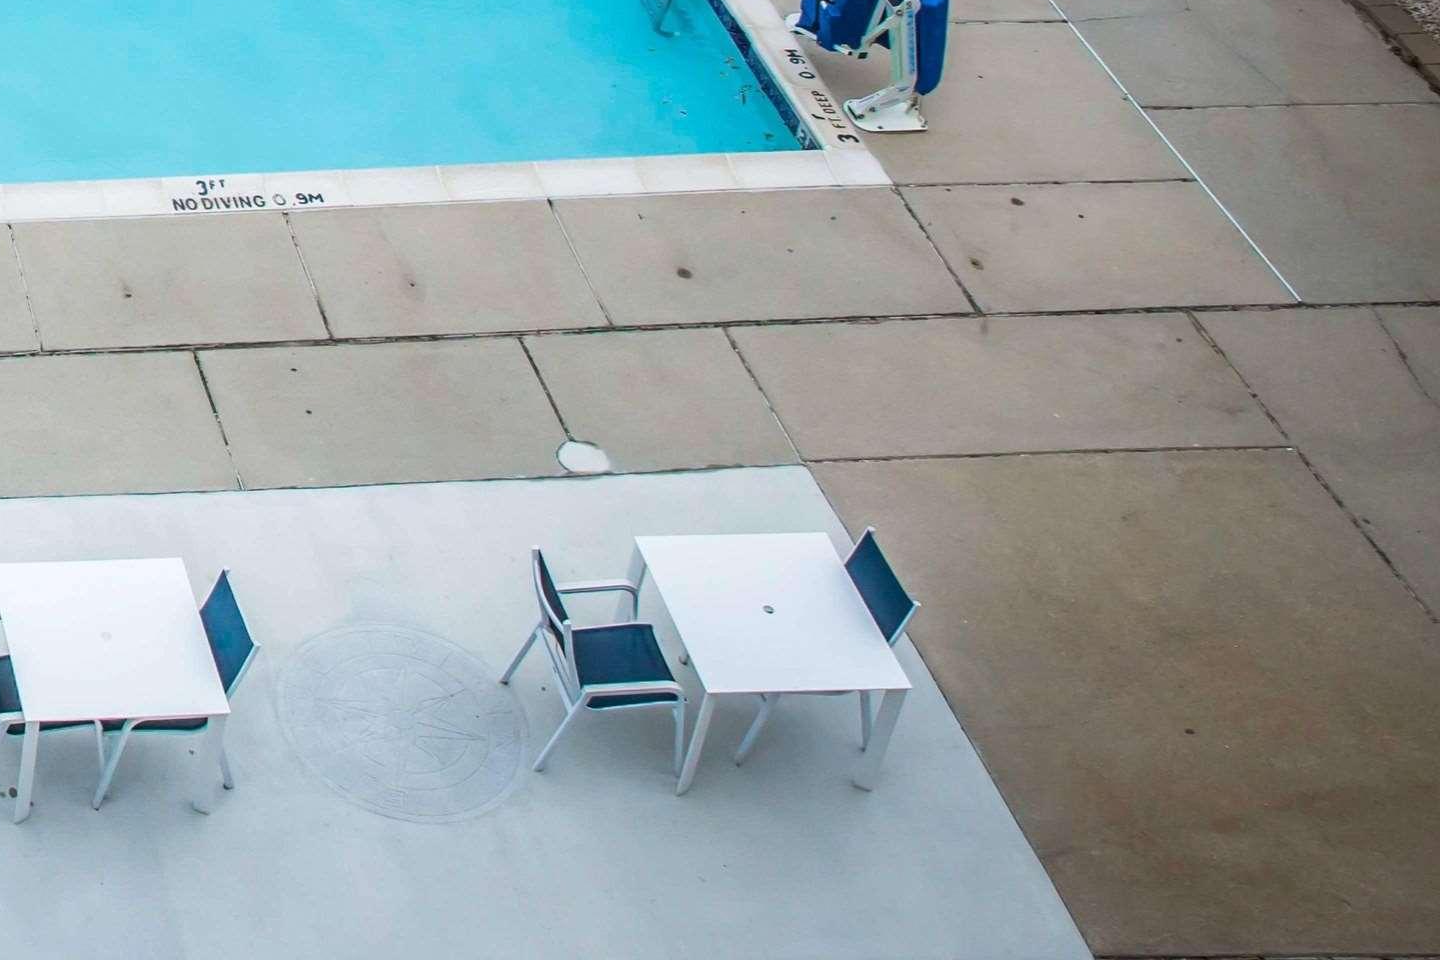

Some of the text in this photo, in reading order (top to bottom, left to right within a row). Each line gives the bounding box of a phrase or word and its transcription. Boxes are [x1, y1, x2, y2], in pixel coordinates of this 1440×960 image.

[784, 48, 816, 80] 0.9M
[811, 90, 837, 114] DEEP
[836, 133, 860, 143] 3
[172, 198, 198, 211] NO
[201, 195, 266, 210] DIVING
